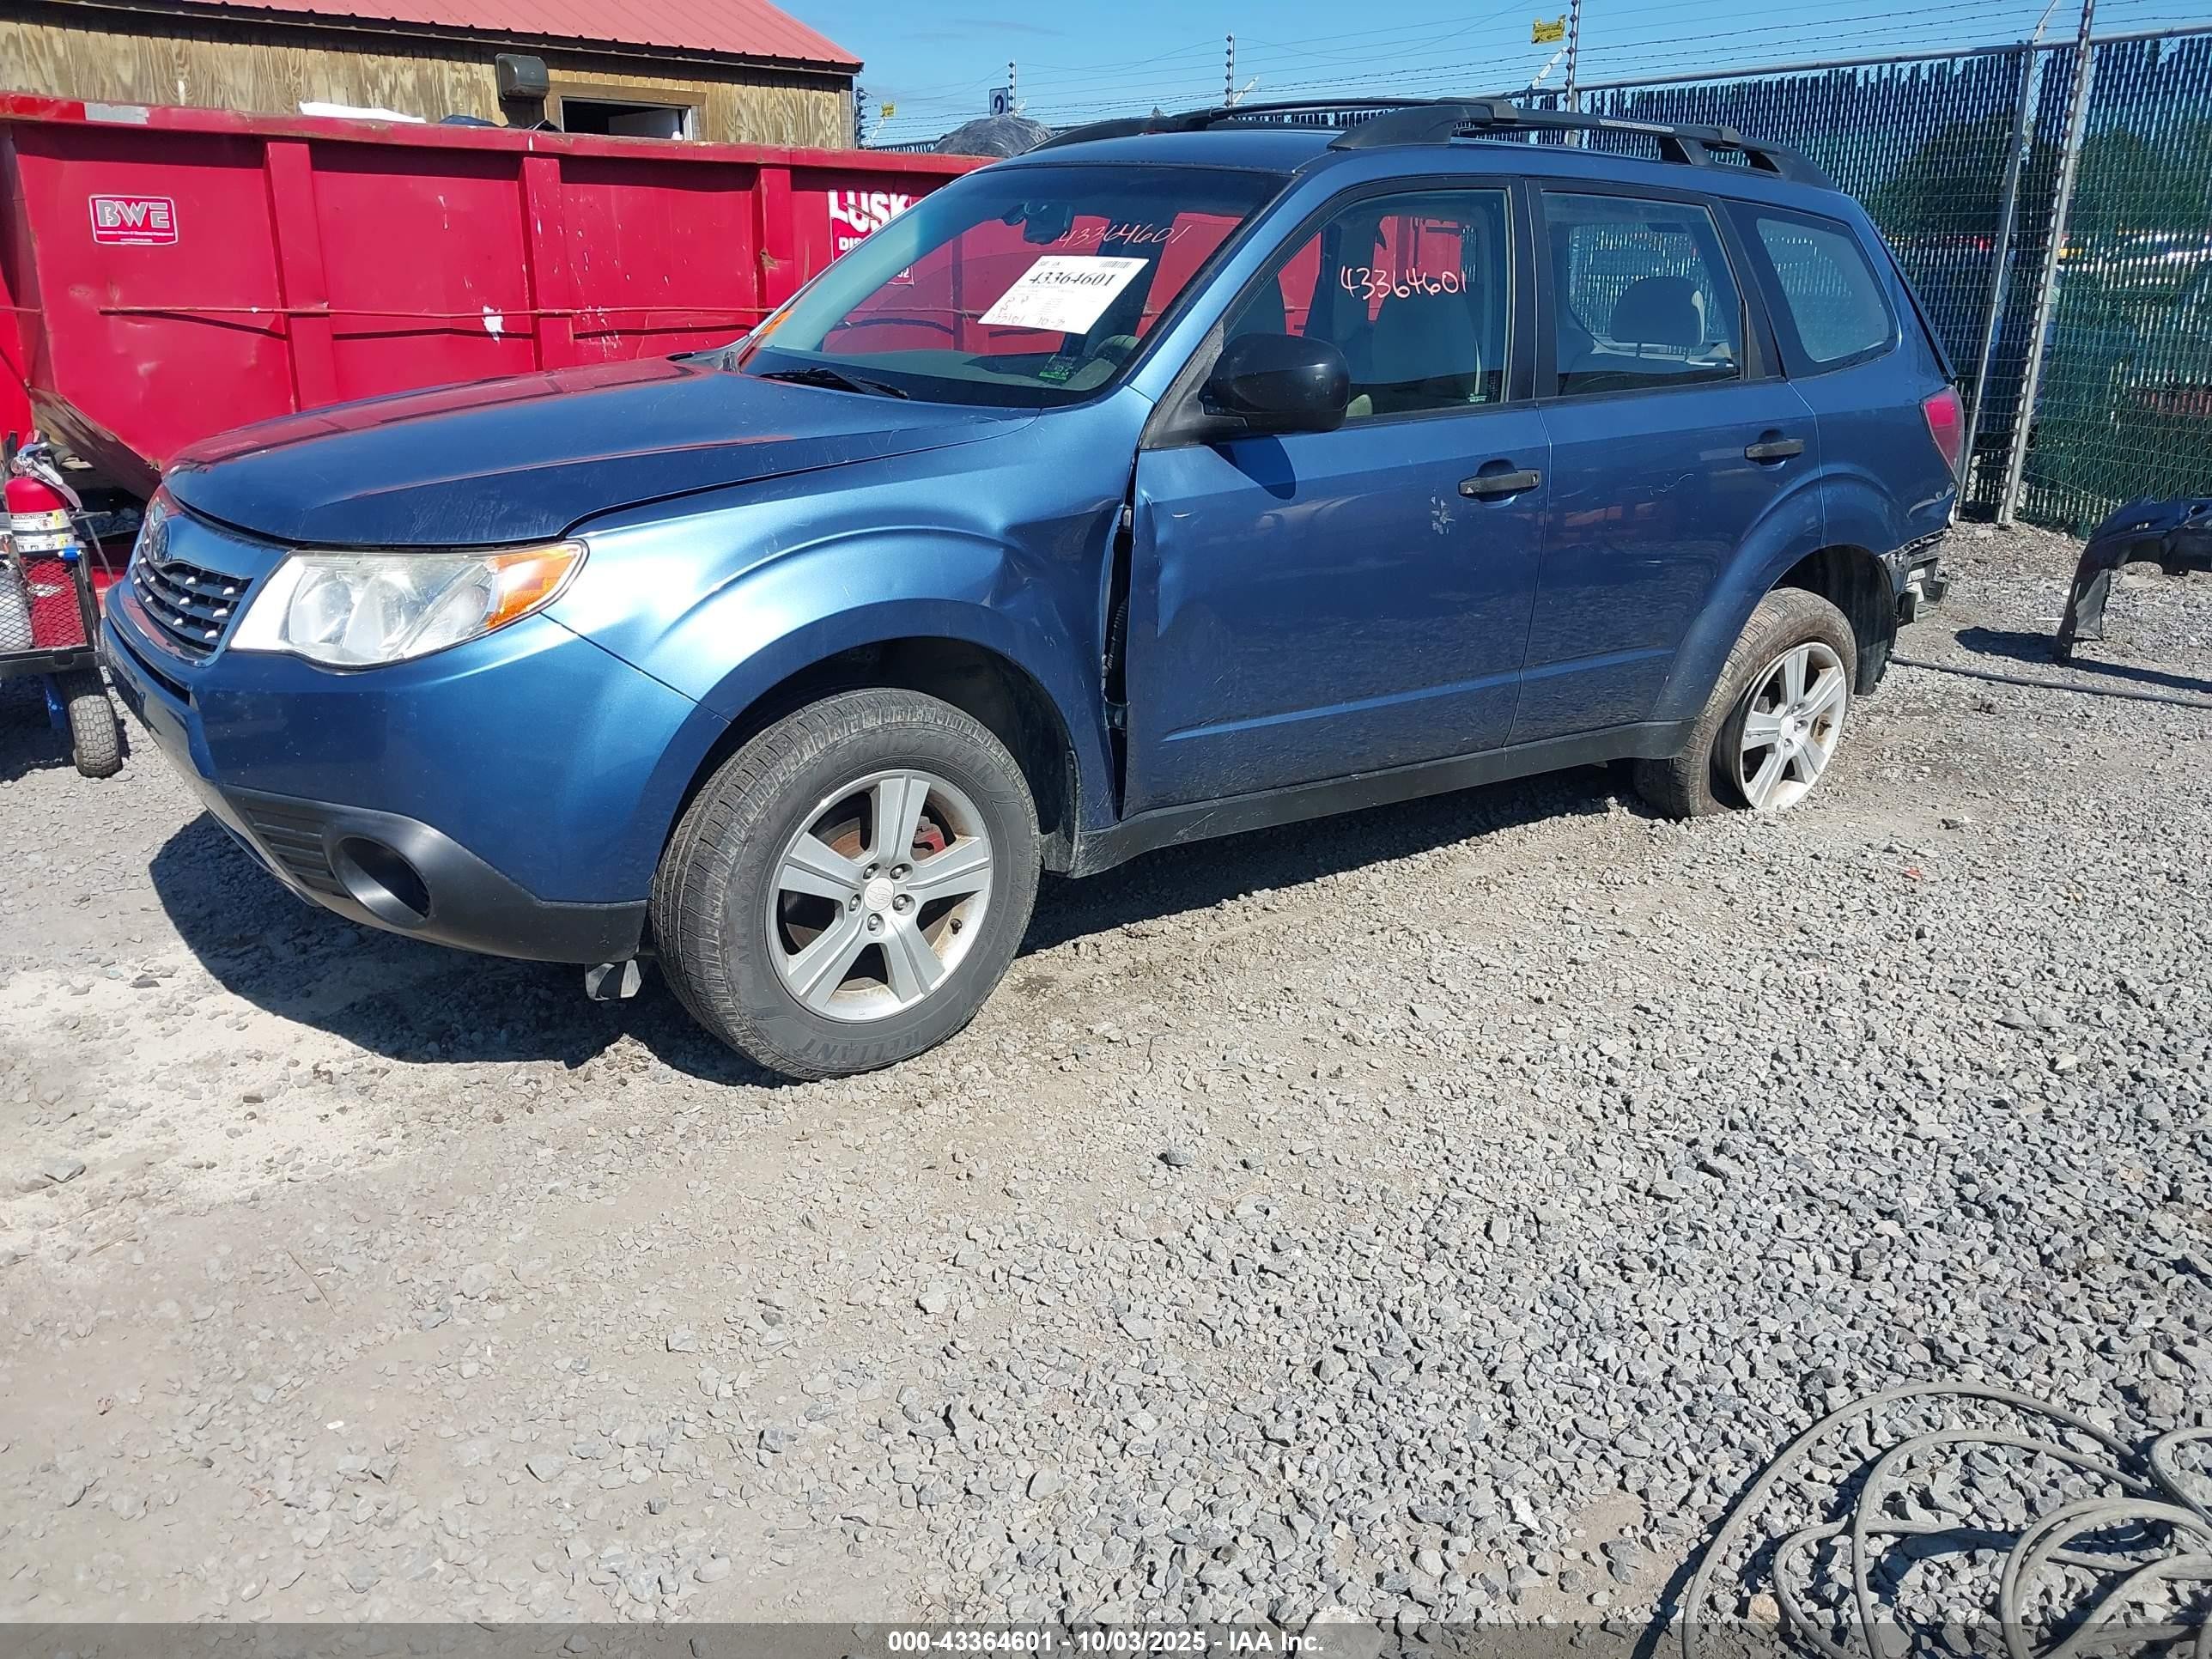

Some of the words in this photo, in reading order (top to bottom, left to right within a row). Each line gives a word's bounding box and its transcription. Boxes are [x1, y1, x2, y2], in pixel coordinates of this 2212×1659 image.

[95, 199, 170, 228] BWE
[828, 190, 909, 233] LUSK
[1058, 222, 1193, 248] 43364601
[1030, 271, 1117, 287] 43364601
[1340, 265, 1467, 301] 43364601
[793, 1030, 921, 1063] RELIANT
